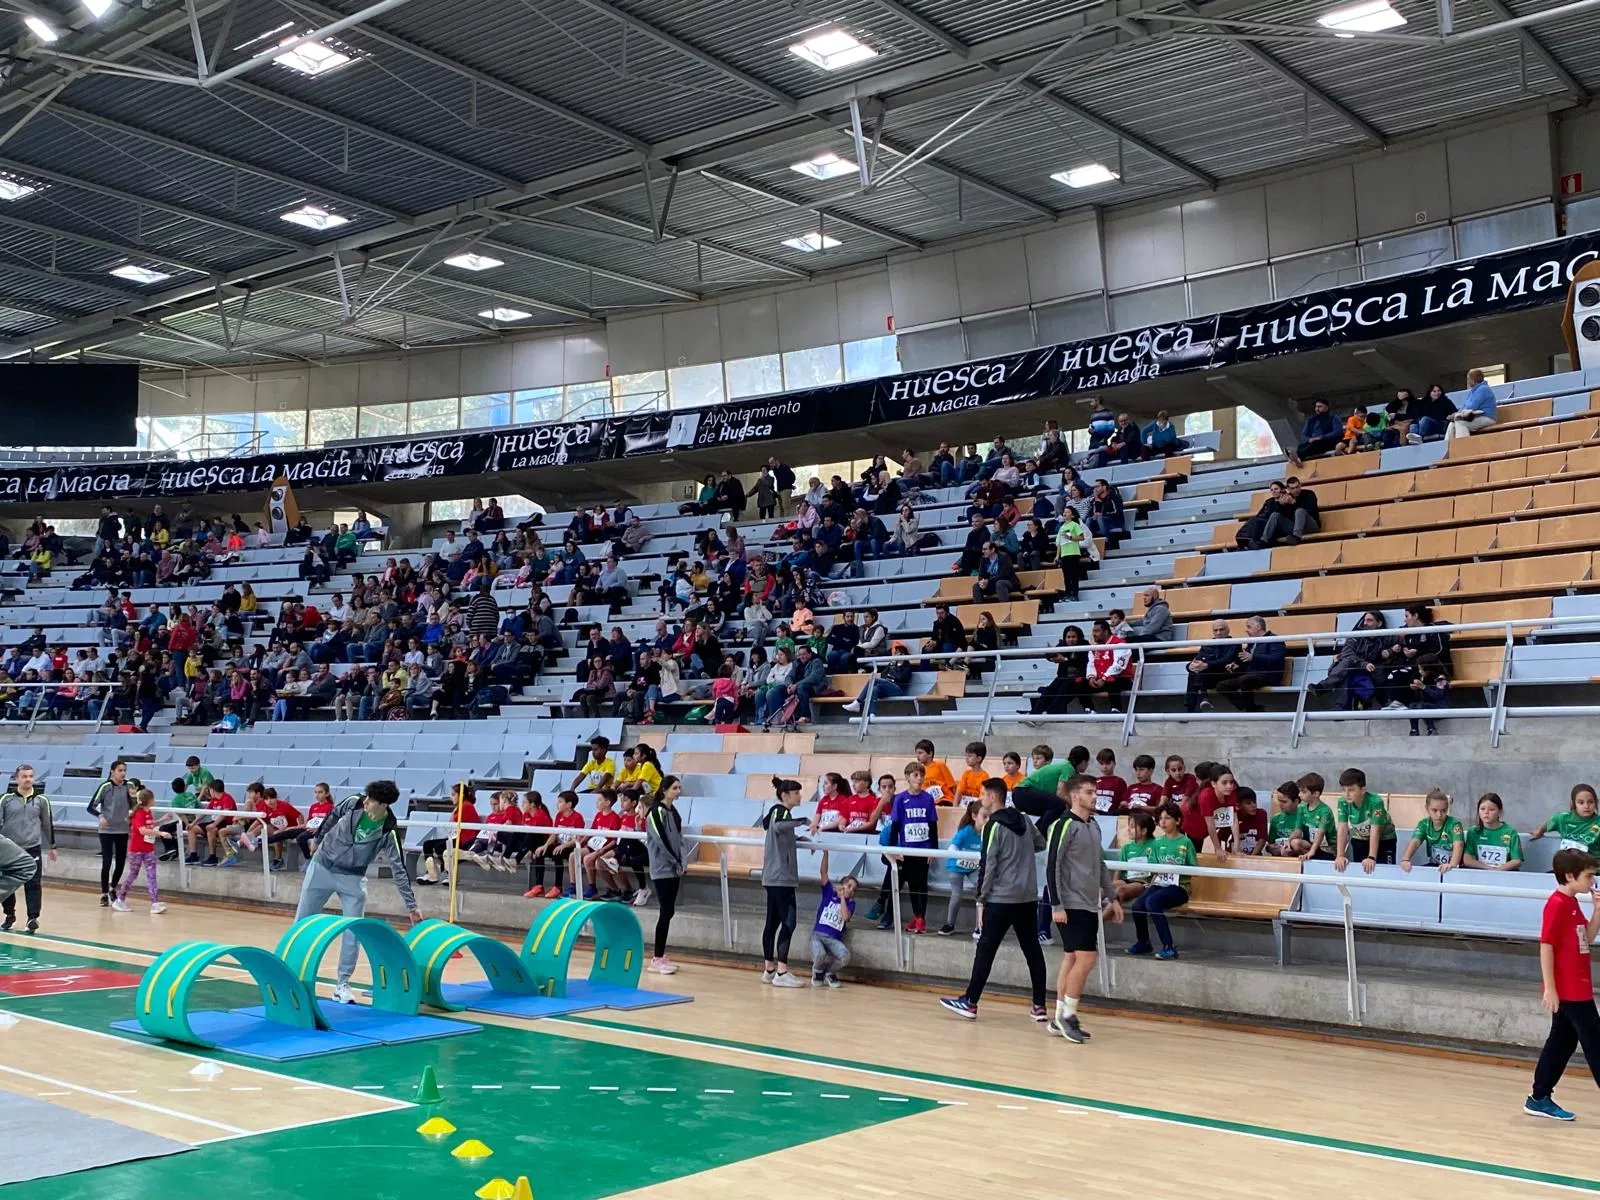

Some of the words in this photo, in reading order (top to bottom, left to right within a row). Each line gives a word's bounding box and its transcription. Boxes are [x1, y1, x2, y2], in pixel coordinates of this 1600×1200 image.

[889, 363, 1006, 400] Huesca
[703, 401, 801, 426] Ayuntamiento
[699, 431, 720, 444] de
[719, 423, 773, 442] Huesca
[905, 808, 927, 818] TIERZ
[1481, 850, 1501, 862] 472
